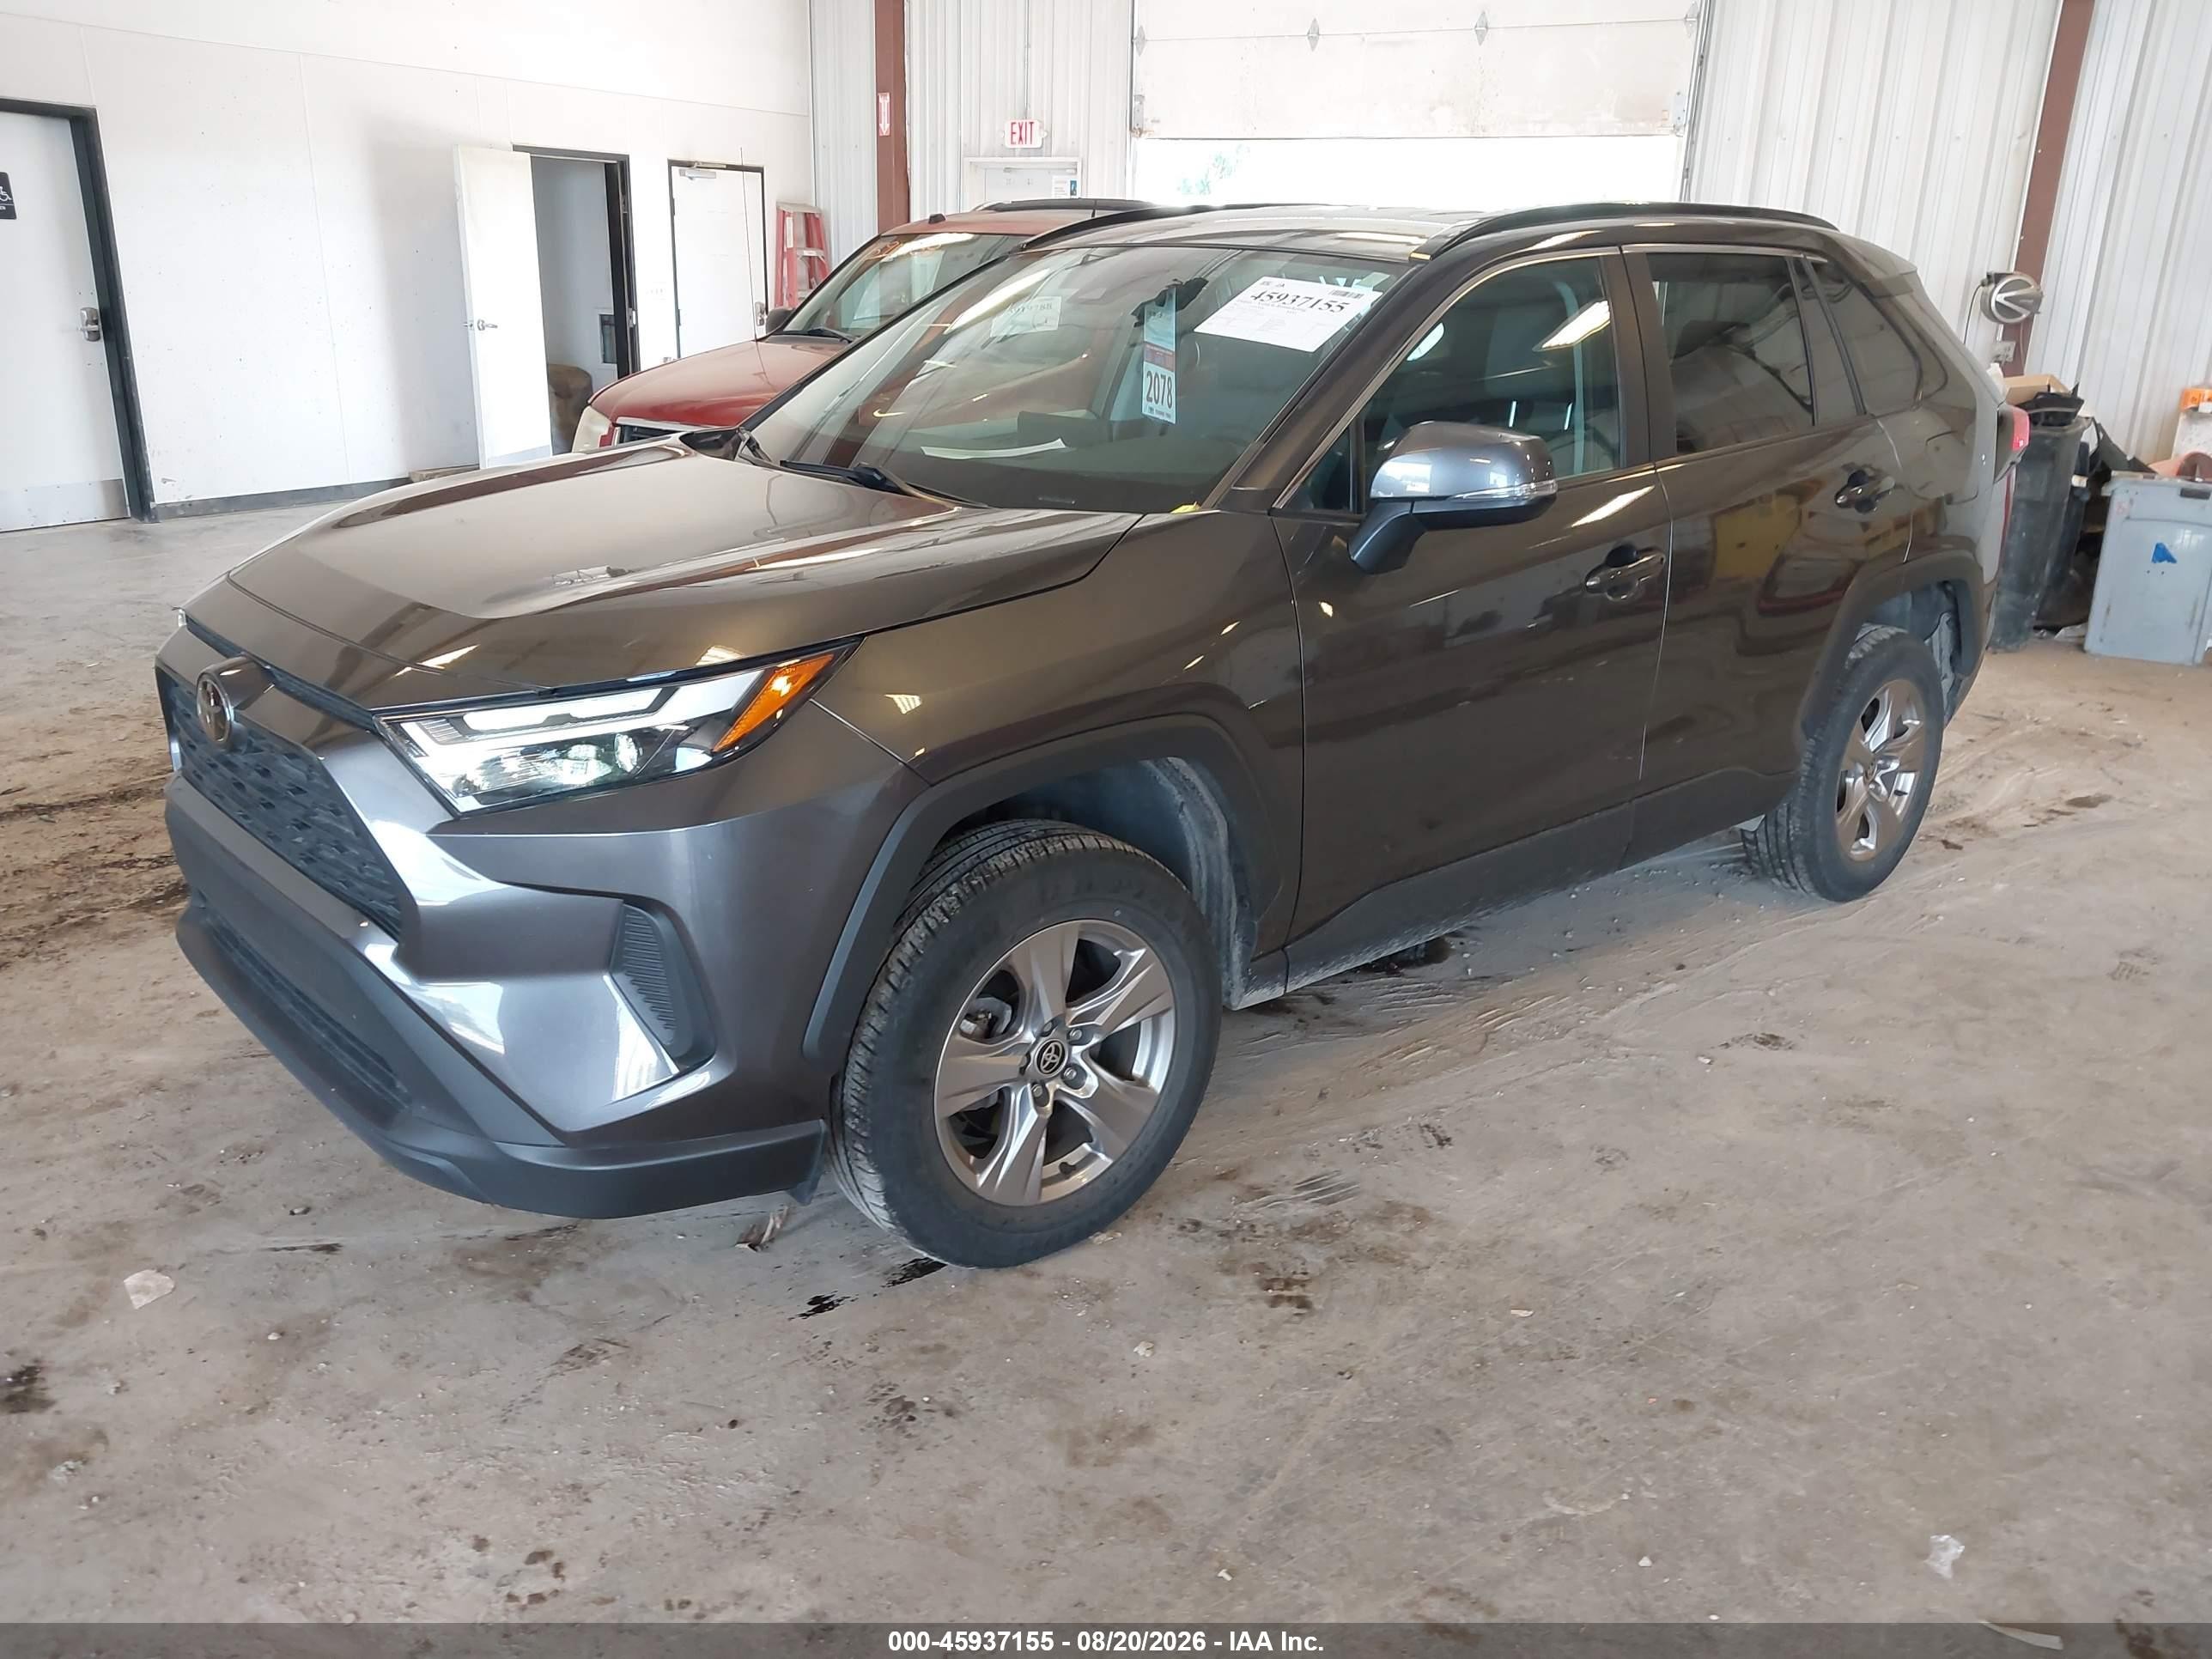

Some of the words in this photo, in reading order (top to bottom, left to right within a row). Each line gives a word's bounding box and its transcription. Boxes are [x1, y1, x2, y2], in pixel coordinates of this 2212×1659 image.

[1010, 121, 1035, 145] EXIT
[1250, 290, 1351, 313] 45937155
[1146, 370, 1174, 409] 2078
